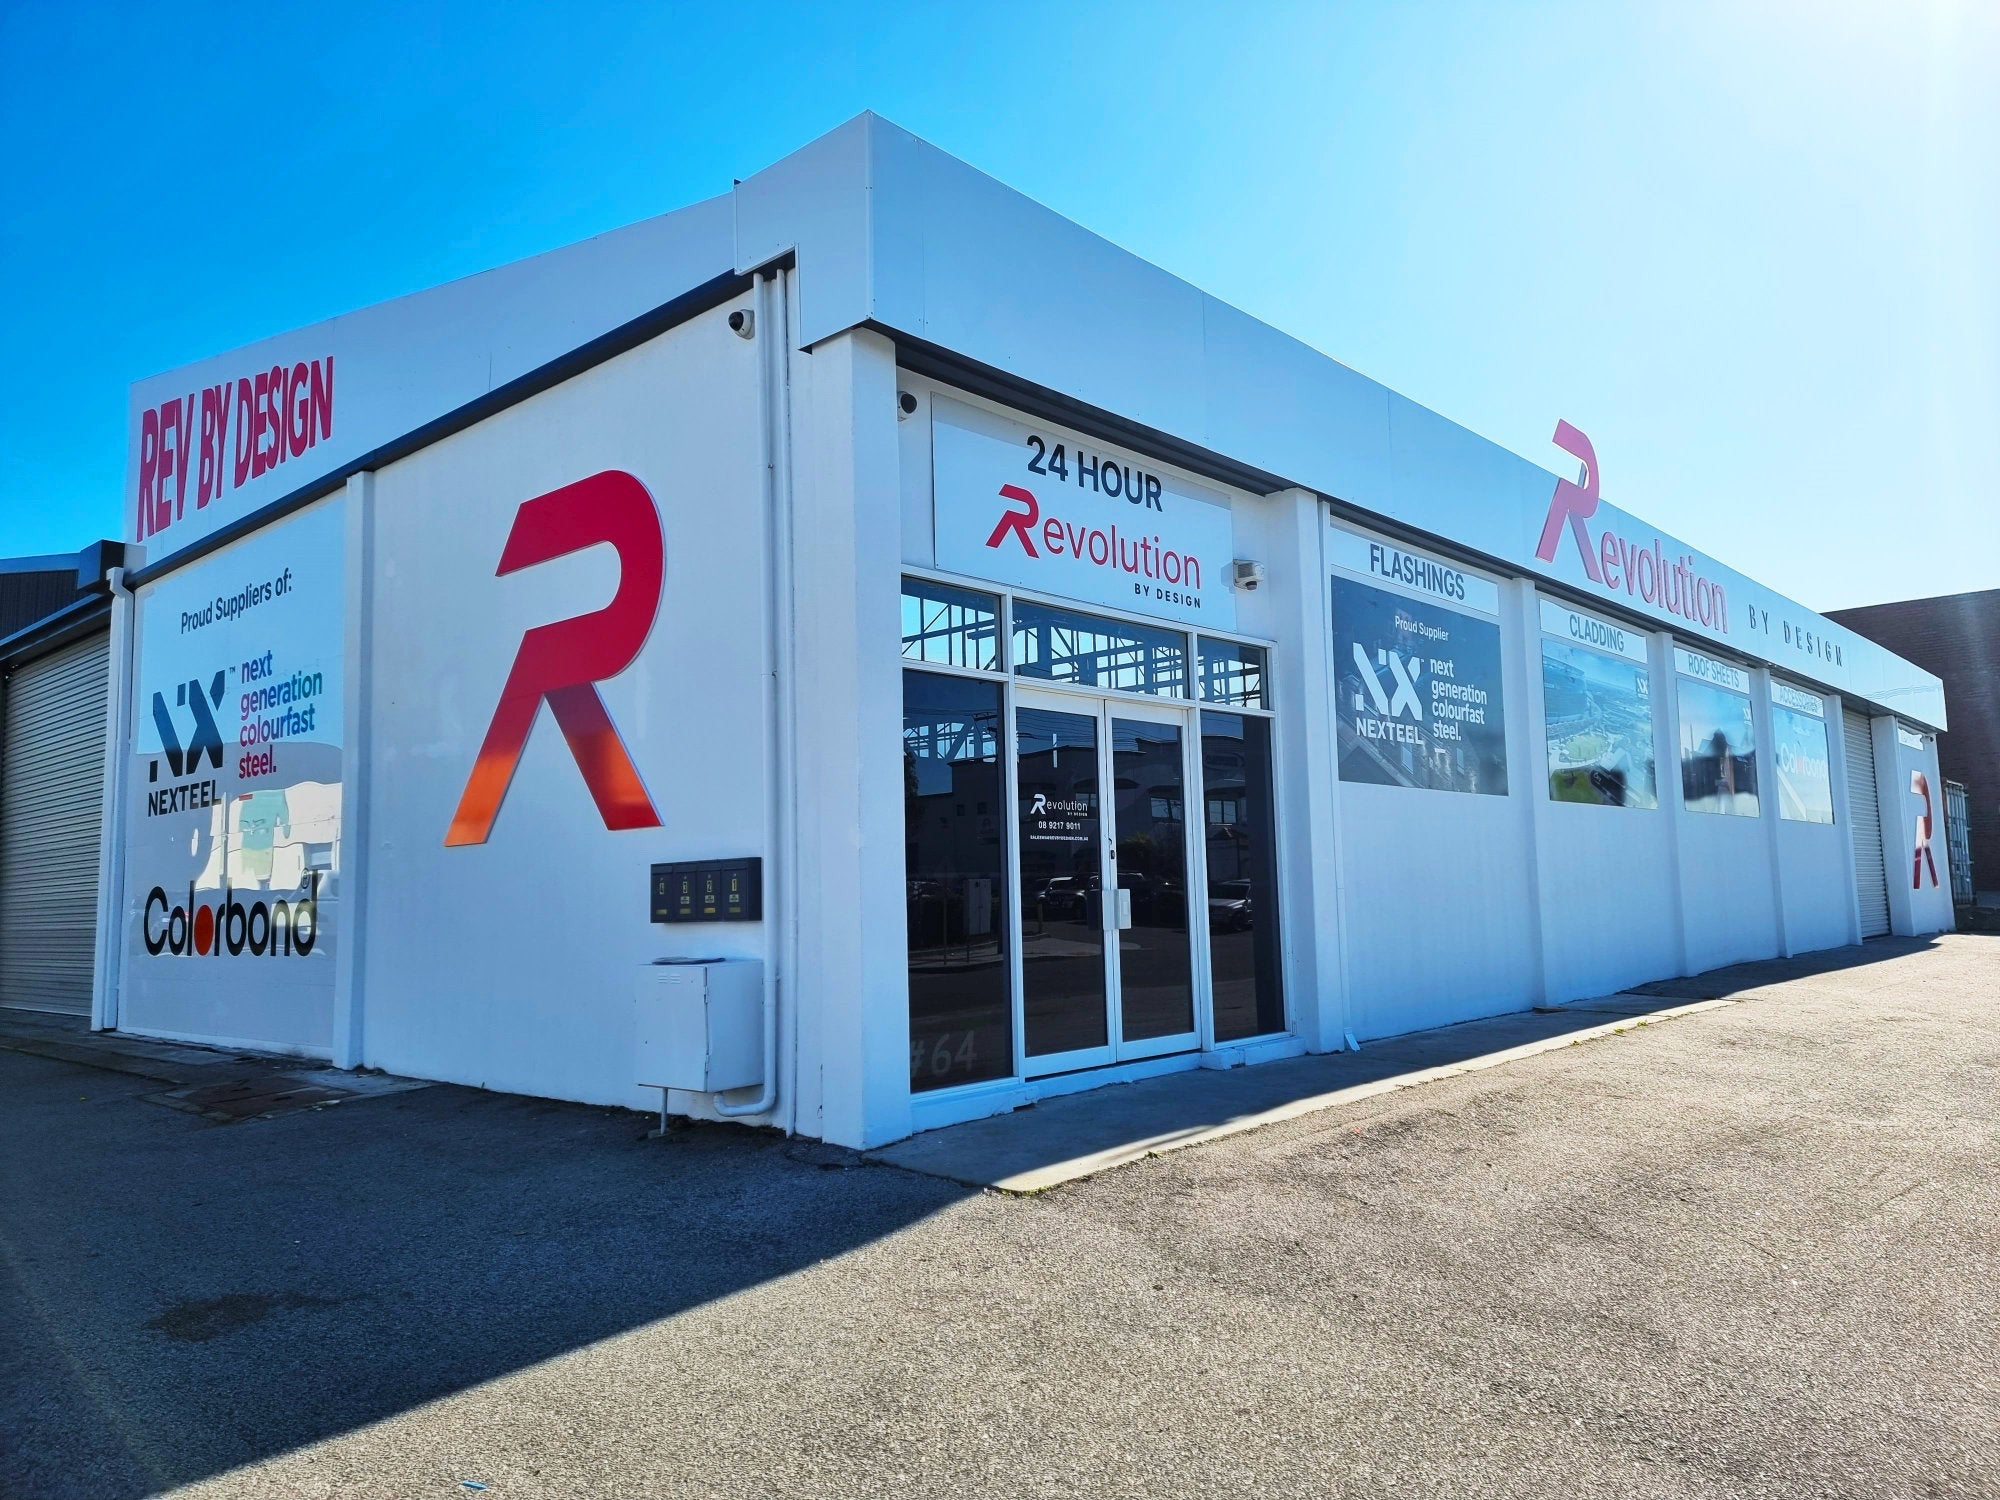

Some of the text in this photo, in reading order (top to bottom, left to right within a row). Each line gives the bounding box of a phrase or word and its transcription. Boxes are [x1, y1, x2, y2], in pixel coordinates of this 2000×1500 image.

[137, 356, 333, 543] REV BY DESIGN
[1027, 435, 1162, 513] 24 HOUR
[985, 483, 1201, 589] Revolution
[1535, 418, 1842, 667] Revolution BY DESIGN
[1370, 543, 1465, 600] FLASHINGS
[181, 567, 292, 634] Proud Suppliers of:
[1134, 583, 1201, 608] BY DESIGN
[1395, 616, 1449, 641] Proud Supplier
[1569, 614, 1624, 652] CLADDING
[241, 650, 272, 684] next
[444, 469, 666, 847] R
[1430, 658, 1454, 678] next
[1688, 654, 1739, 688] ROOF SHEETS
[240, 670, 322, 721] generation
[1431, 680, 1487, 705] generation
[239, 703, 315, 747] colourfast
[1432, 699, 1485, 725] colourfast
[1433, 720, 1461, 740] steel.
[1356, 717, 1424, 745] NEXTEEL
[238, 745, 276, 779] steel.
[148, 779, 221, 817] NEXTEEL
[1030, 793, 1088, 814] Revolution
[1038, 821, 1080, 830] 08 9217 9011
[144, 868, 318, 956] Colorbond
